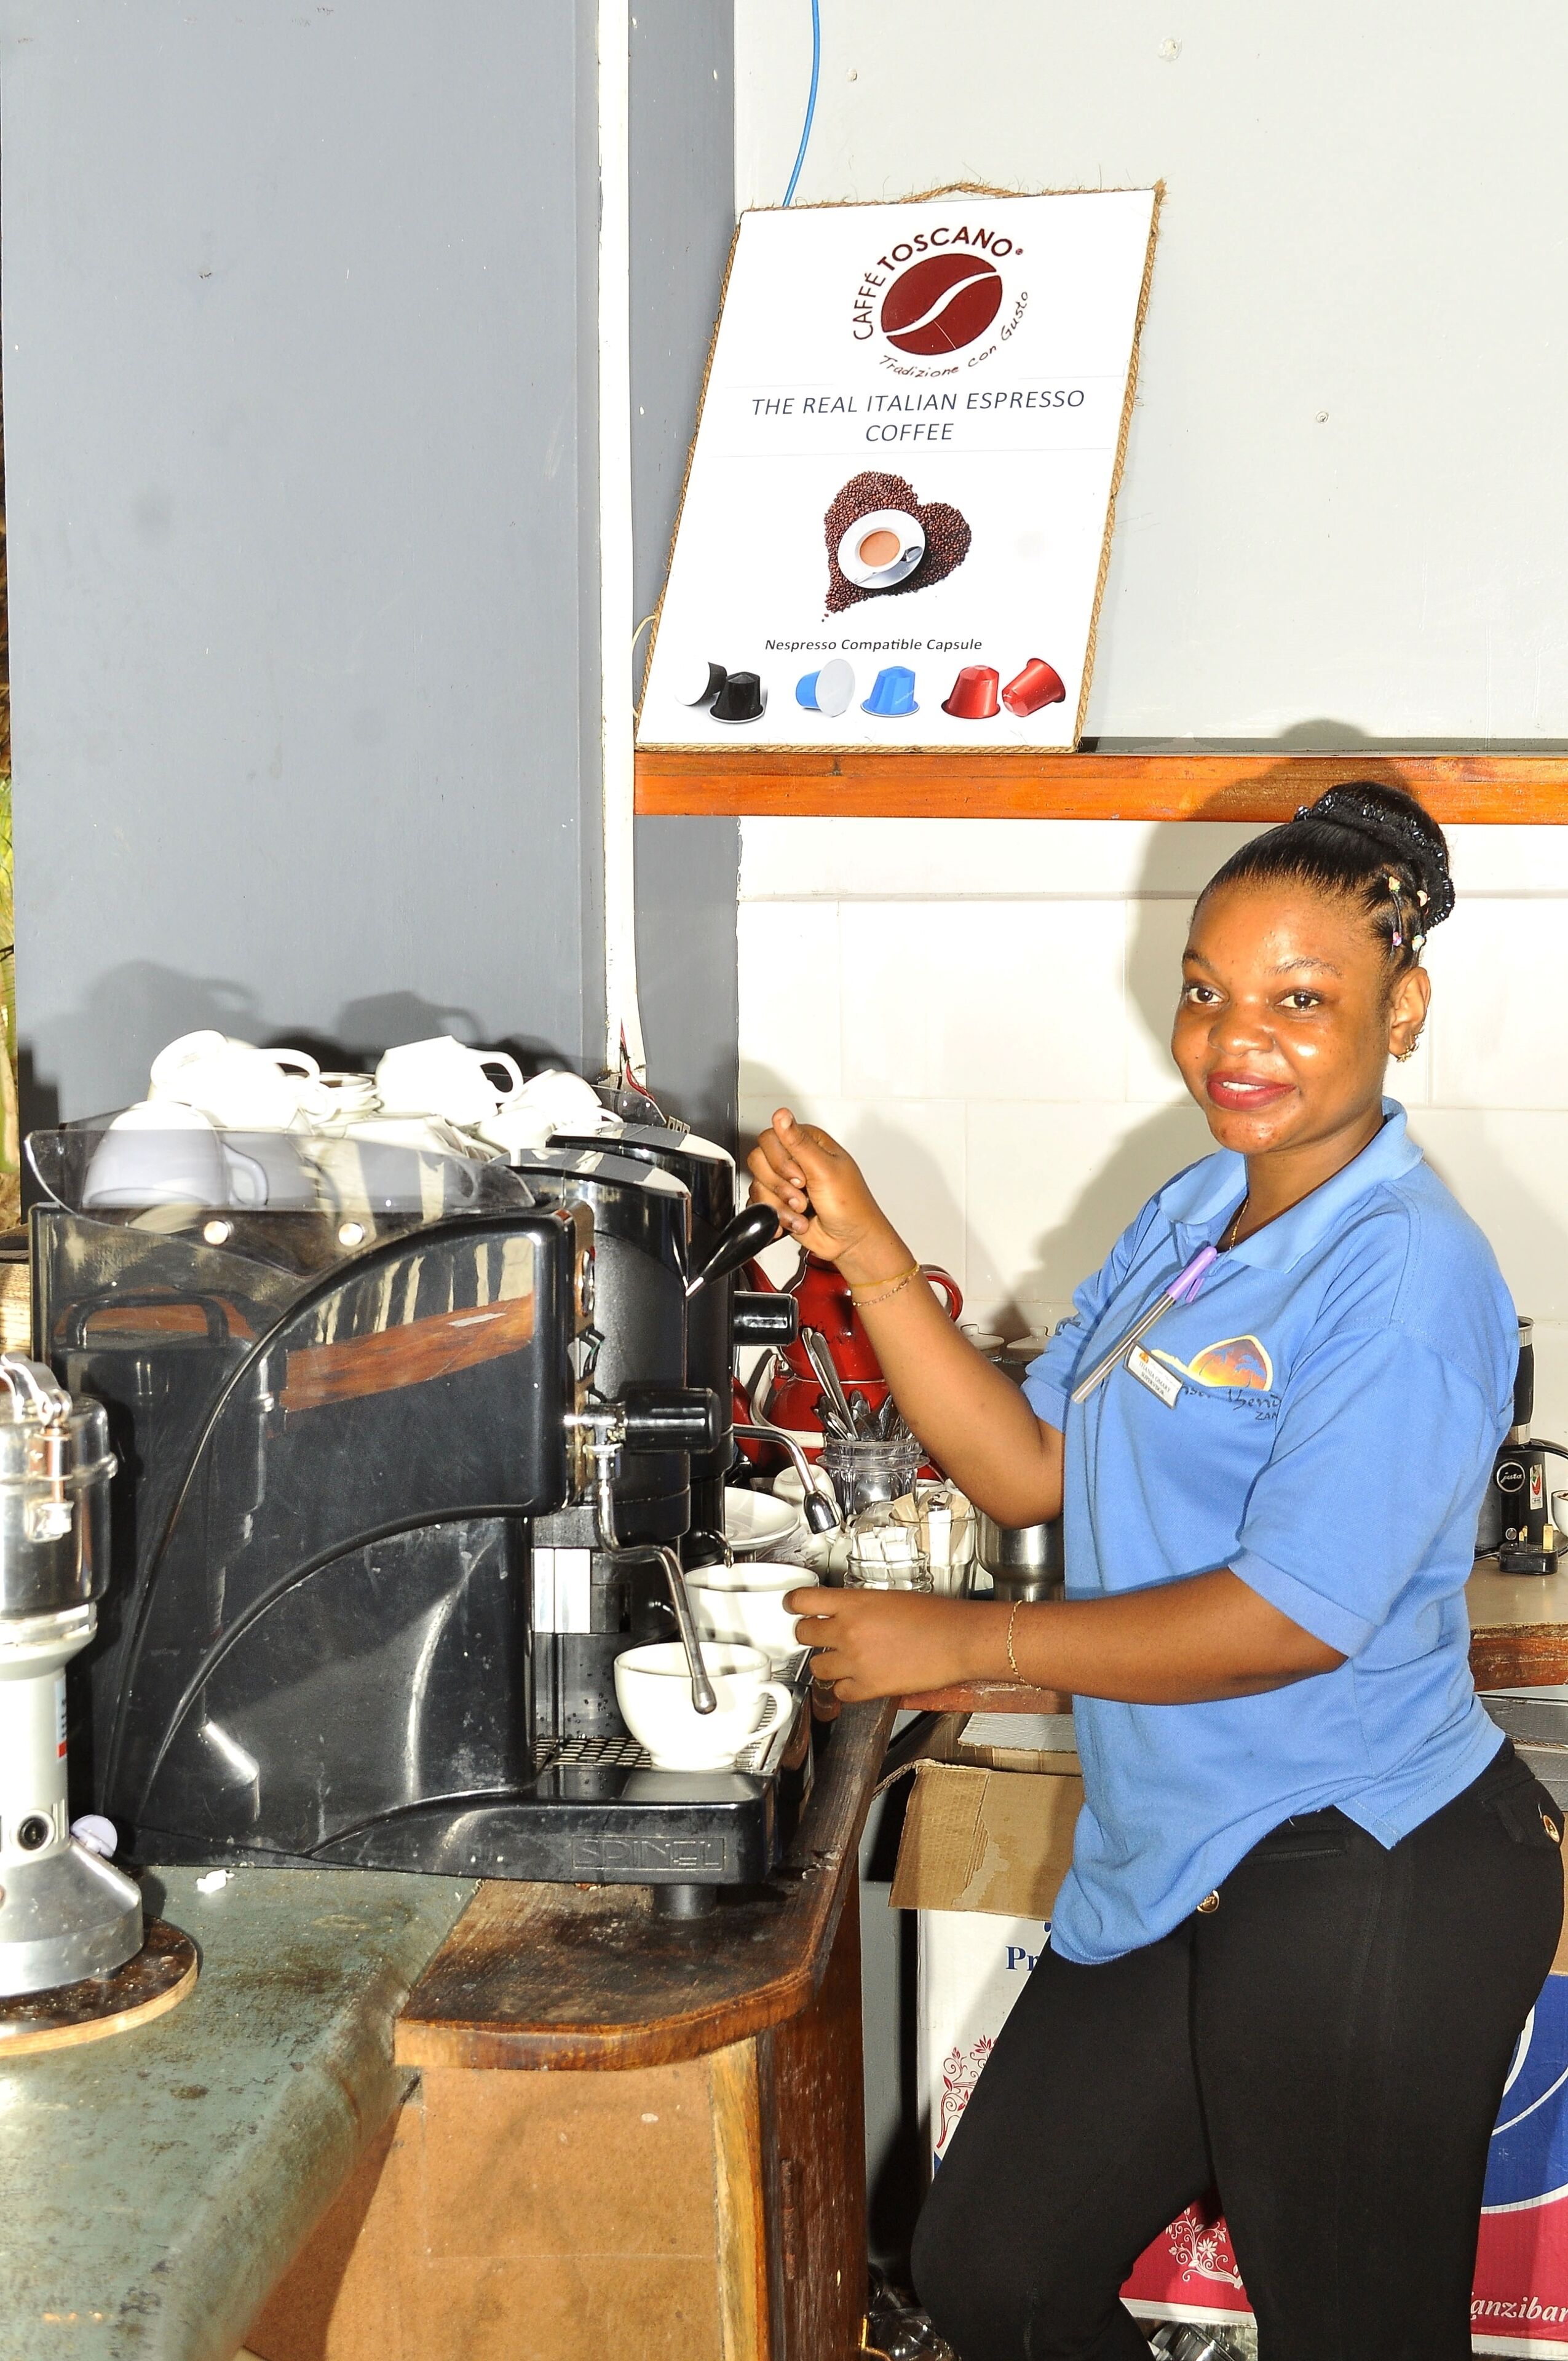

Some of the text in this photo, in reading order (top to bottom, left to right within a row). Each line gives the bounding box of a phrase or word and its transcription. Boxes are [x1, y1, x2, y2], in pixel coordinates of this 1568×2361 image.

[879, 291, 1028, 378] Tradizione con Gusto
[752, 390, 1085, 416] THE REAL ITALIAN ESPRESSO
[866, 423, 954, 441] COFFEE
[765, 638, 982, 653] Nespresso Compatible Capsule
[1470, 2292, 1568, 2322] anzibar
